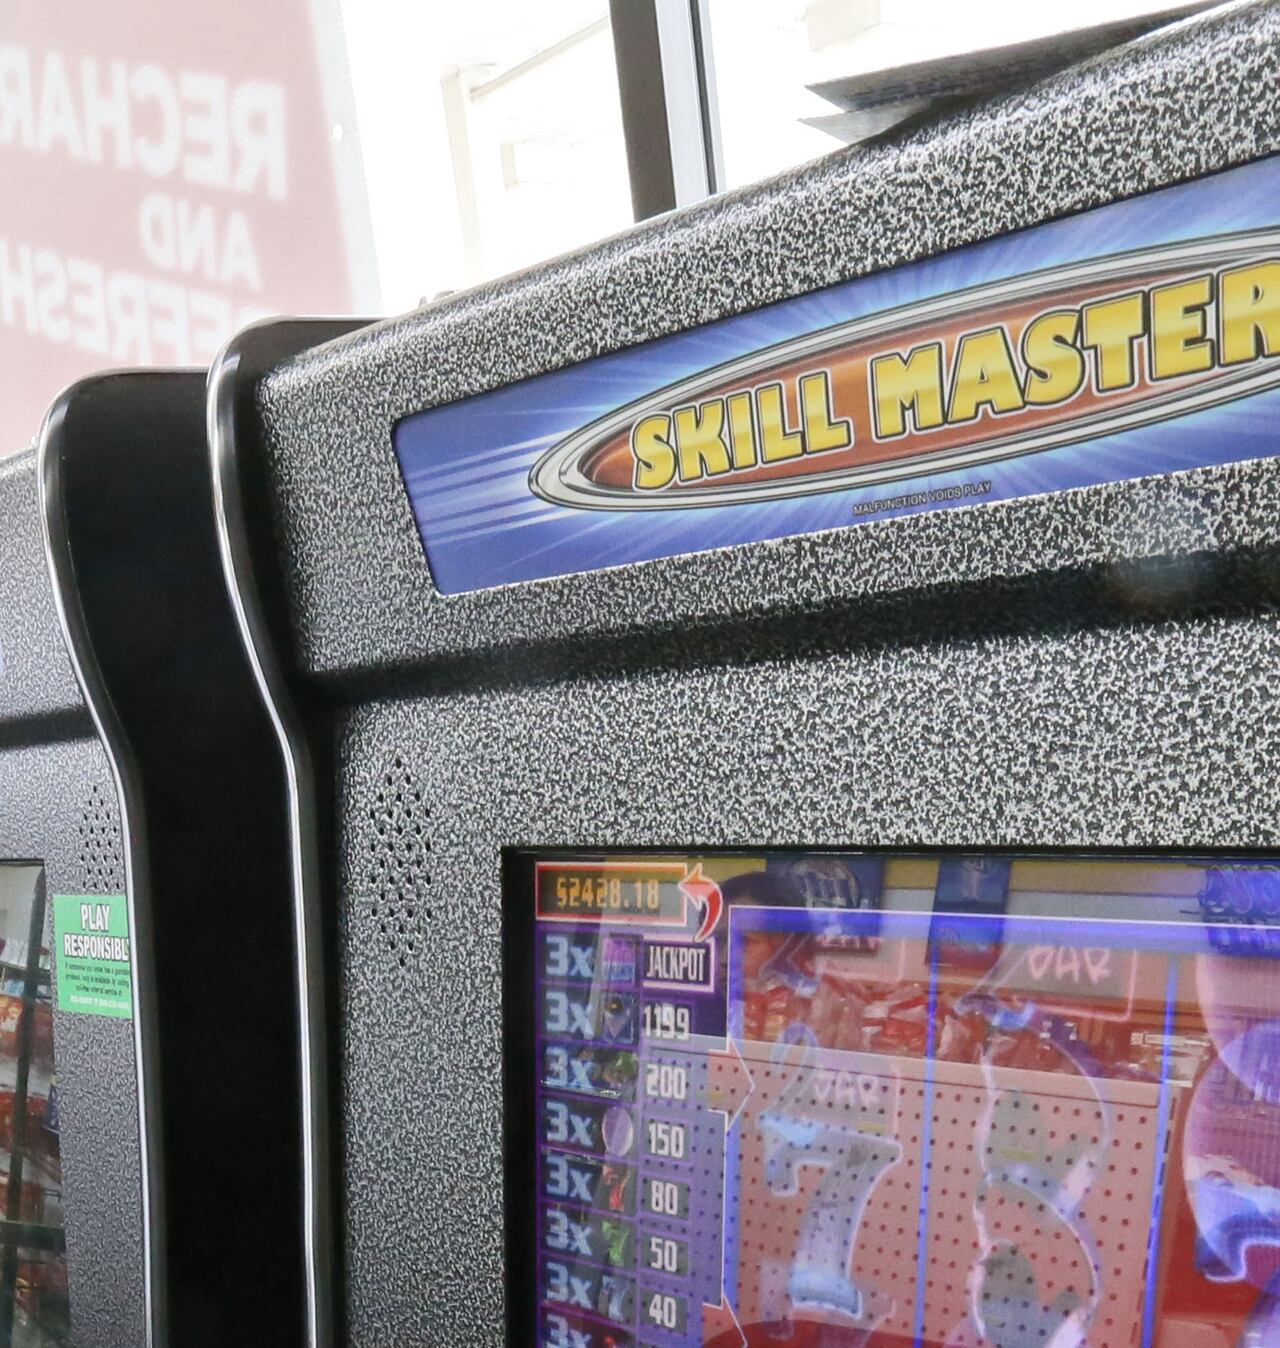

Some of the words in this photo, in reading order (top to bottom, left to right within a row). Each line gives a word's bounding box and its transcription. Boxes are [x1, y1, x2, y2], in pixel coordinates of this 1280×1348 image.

[628, 369, 852, 493] SKILL
[853, 494, 927, 516] MALFUNCTION
[929, 487, 962, 503] VOIDS
[963, 480, 993, 498] PLAY
[80, 903, 110, 933] PLAY
[63, 932, 130, 963] RESPONSIBL
[646, 944, 707, 983] JACKPOT
[645, 1063, 688, 1101] 200
[647, 1121, 685, 1160] 150
[650, 1178, 679, 1217] 80
[650, 1236, 679, 1274] 50
[648, 1293, 677, 1330] 40
